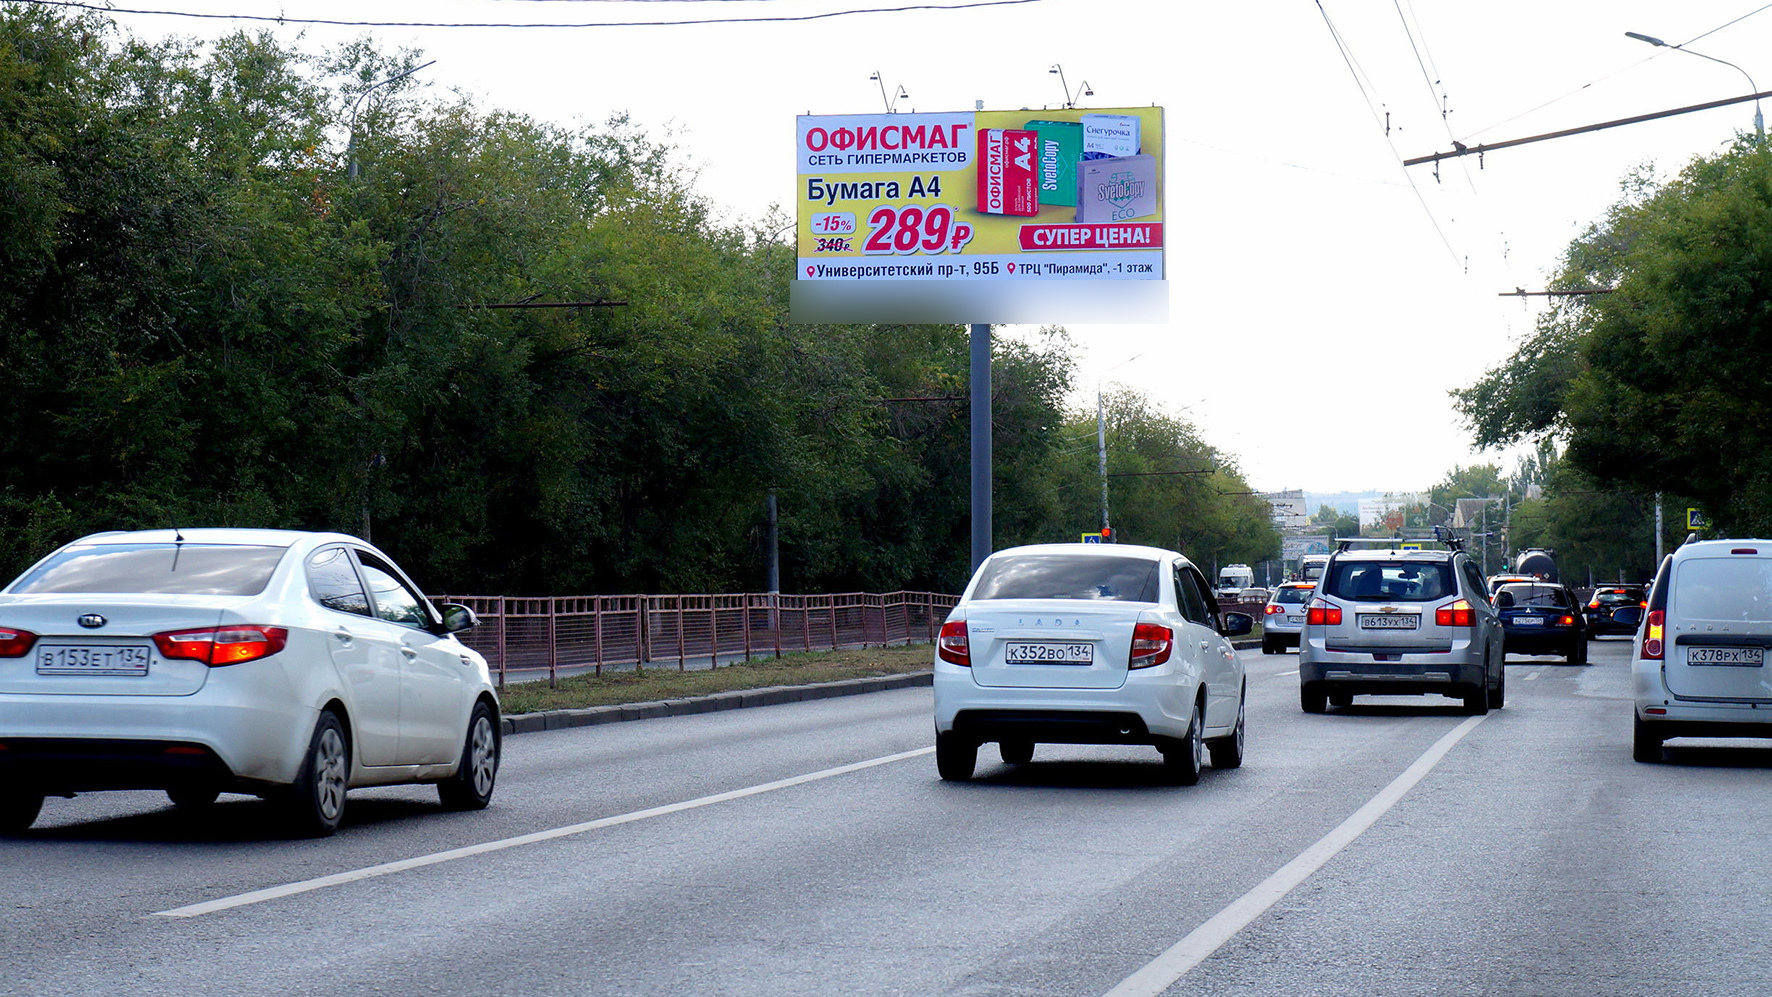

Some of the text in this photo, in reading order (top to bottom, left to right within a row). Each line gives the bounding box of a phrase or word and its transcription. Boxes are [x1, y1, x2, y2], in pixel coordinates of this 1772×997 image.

[806, 124, 967, 152] ОФИСМАГ
[1086, 126, 1130, 136] Снегурочка
[808, 152, 966, 166] СЕТЬ ГИПЕРМАРКЕТОВ
[1042, 140, 1060, 190] SvetoCopy
[990, 136, 1001, 209] ОФИСМАГ
[808, 178, 900, 206] Бумага
[1098, 180, 1146, 202] SvetoCopy
[1112, 208, 1135, 220] ECO
[816, 216, 852, 231] -15%
[1033, 228, 1150, 247] СУПЕР ЦЕНА!
[817, 262, 999, 279] Университетский пр-т, 95Б
[1019, 264, 1041, 276] ТРЦ
[1112, 262, 1122, 273] -1
[1126, 264, 1152, 273] этаж
[80, 616, 103, 626] KIA
[1018, 618, 1082, 626] LADA
[118, 648, 145, 662] 134
[1068, 644, 1090, 656] 134
[1742, 650, 1760, 659] 134
